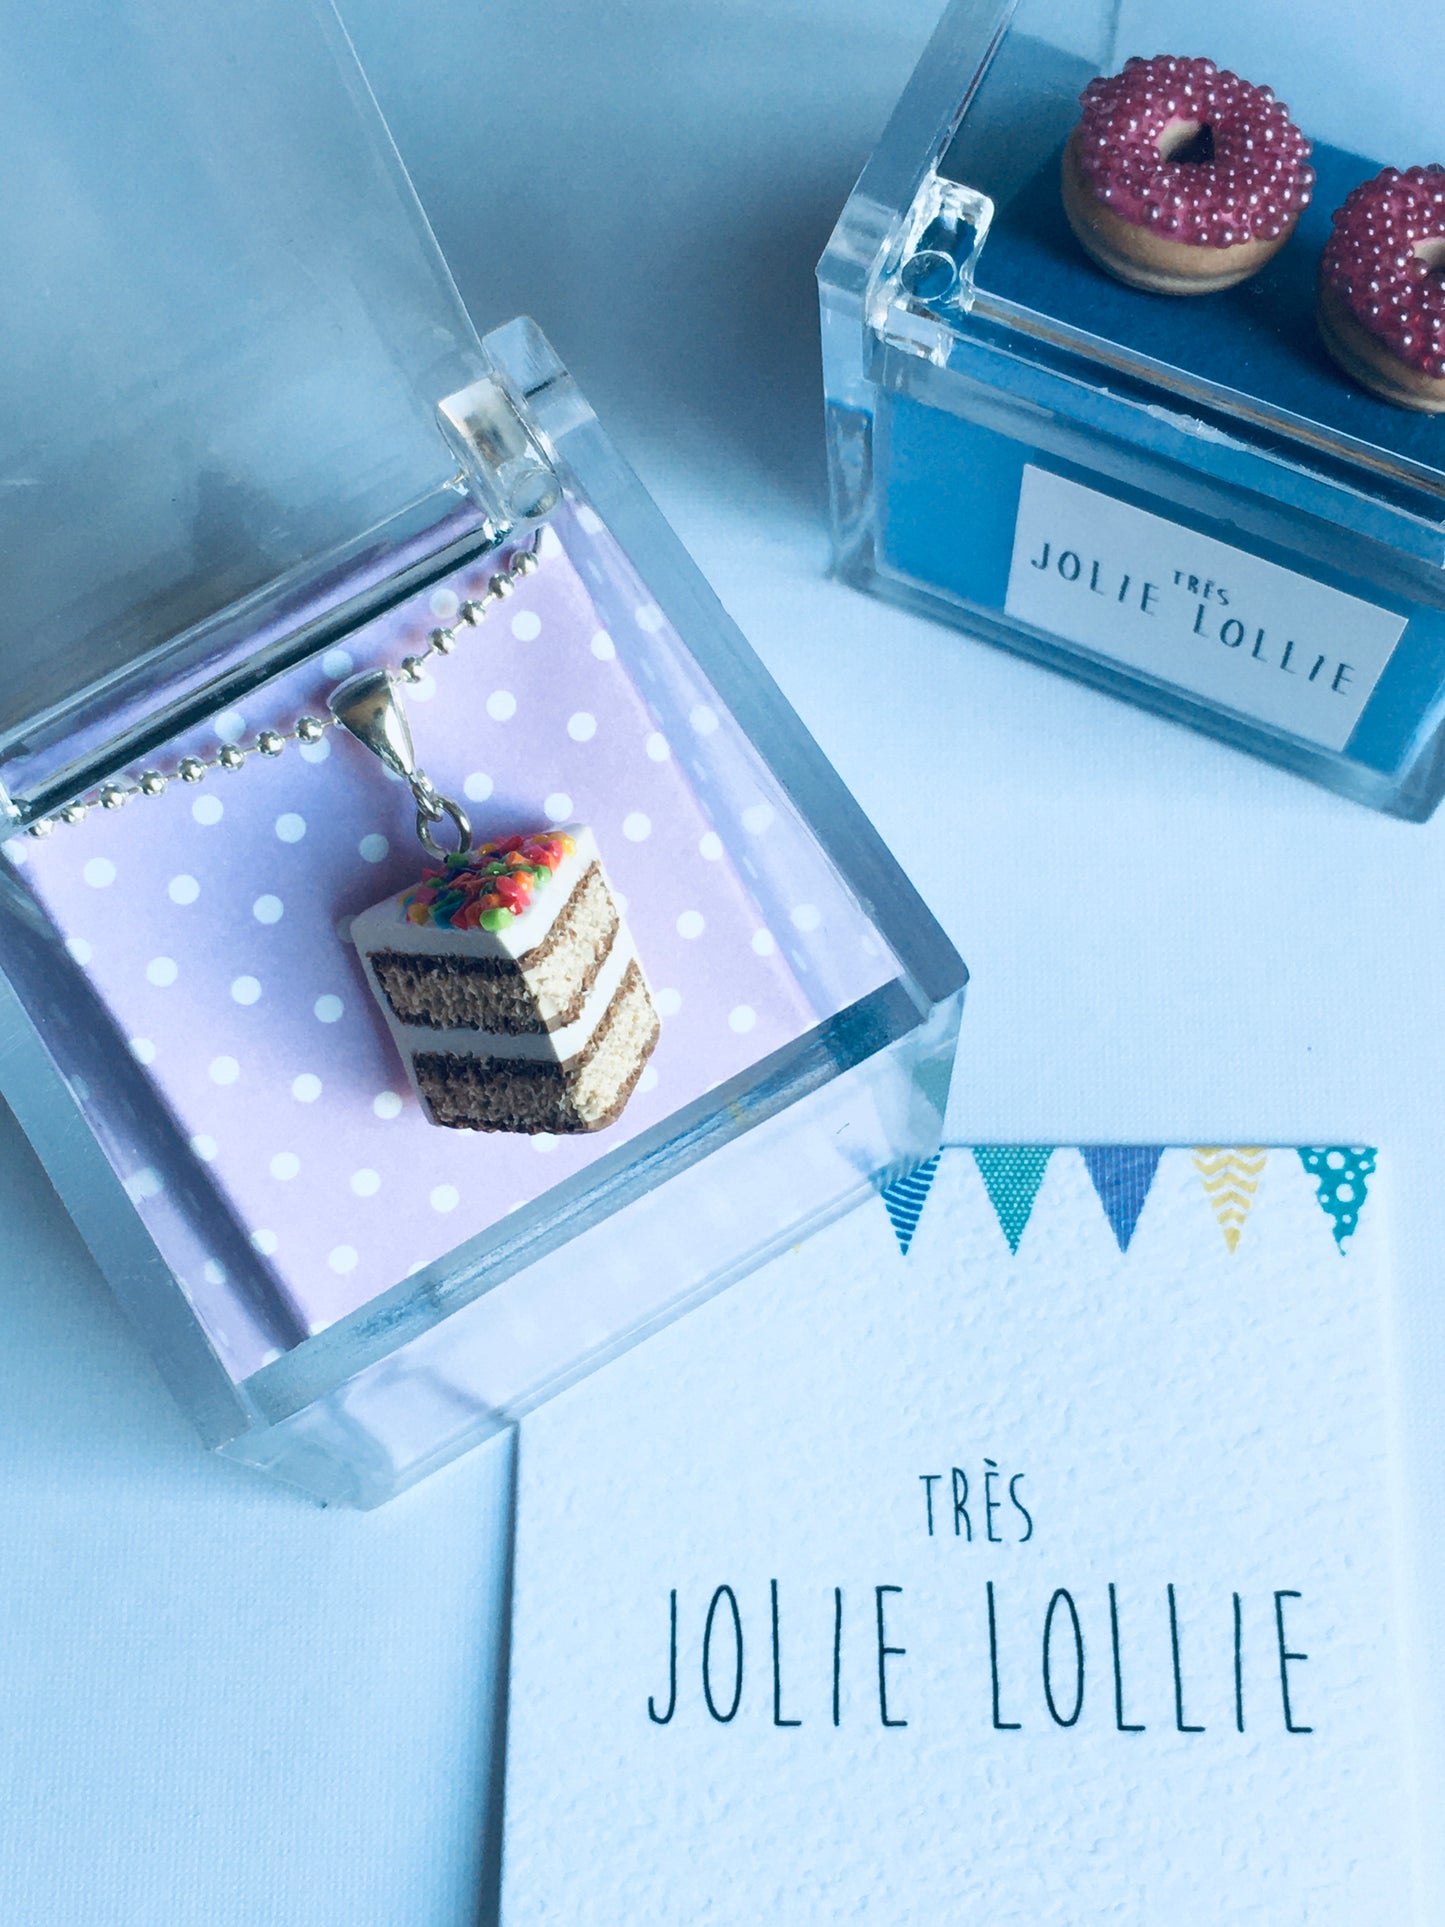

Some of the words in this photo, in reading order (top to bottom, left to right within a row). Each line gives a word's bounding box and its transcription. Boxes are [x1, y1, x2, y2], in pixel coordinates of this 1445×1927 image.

[1030, 542, 1161, 617] JOLIE
[1193, 603, 1356, 696] LOLLIE
[918, 1457, 1034, 1544] TRÈS
[647, 1577, 909, 1728] JOLIE
[985, 1579, 1314, 1734] LOLLIE
